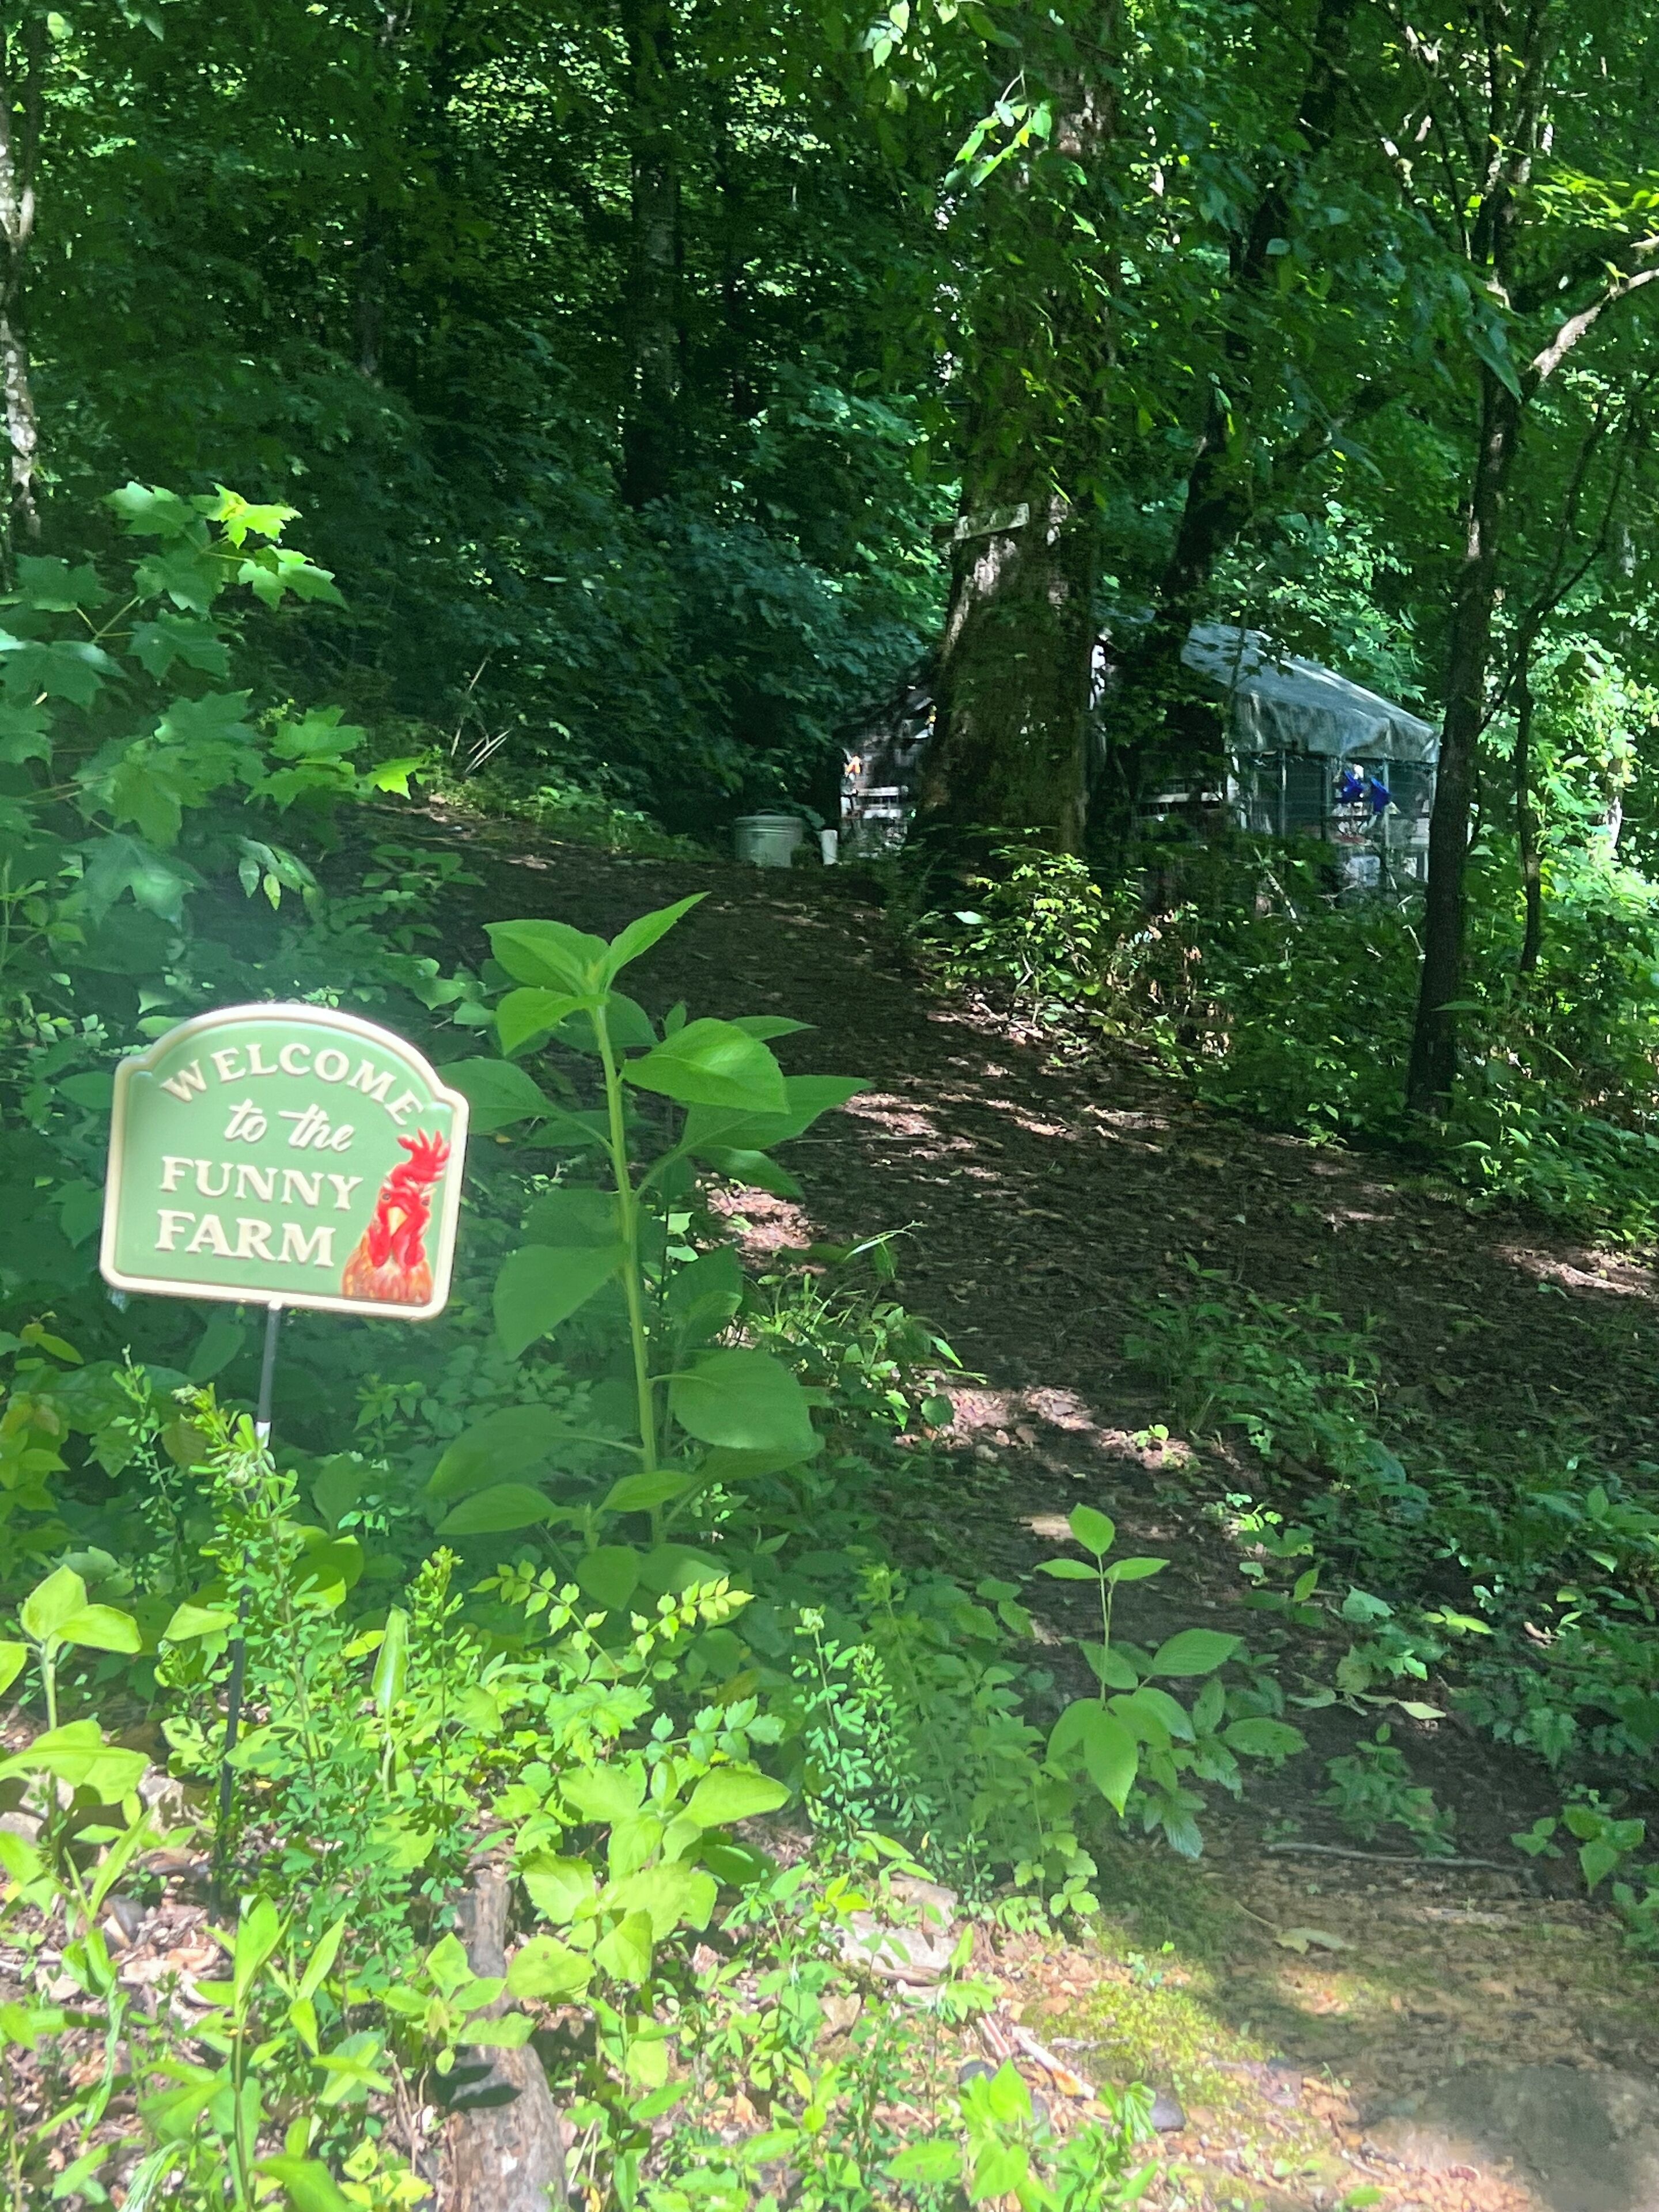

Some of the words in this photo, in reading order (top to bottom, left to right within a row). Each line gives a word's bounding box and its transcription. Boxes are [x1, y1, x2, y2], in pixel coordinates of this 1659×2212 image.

[160, 1043, 424, 1126] WELCOME
[224, 1098, 267, 1143] to
[278, 1103, 355, 1152] the
[158, 1156, 363, 1210] FUNNY
[154, 1209, 336, 1267] FARM
